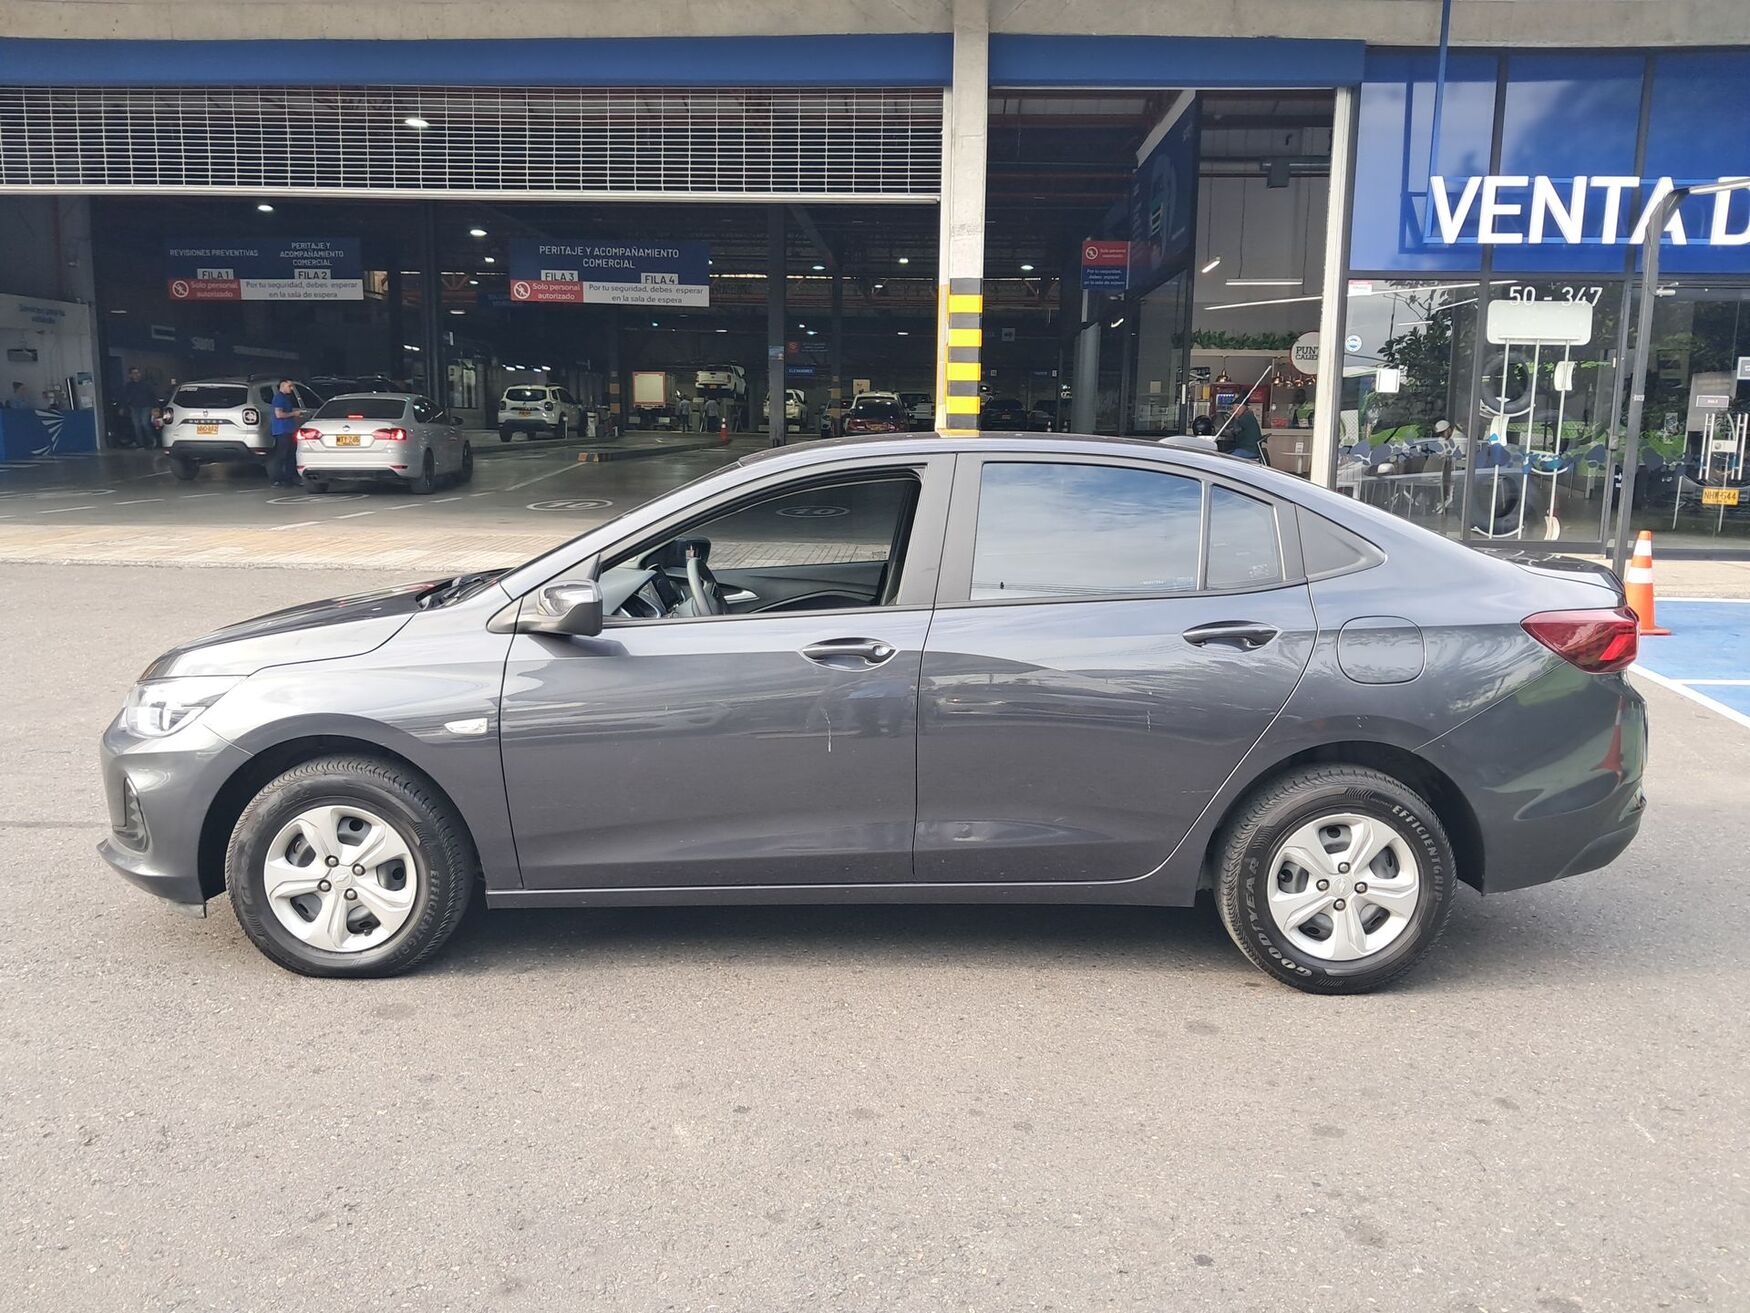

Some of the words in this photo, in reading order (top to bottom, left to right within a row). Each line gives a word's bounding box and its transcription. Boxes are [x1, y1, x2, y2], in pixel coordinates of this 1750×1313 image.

[1430, 175, 1687, 246] VENTA
[539, 245, 584, 256] PERITAJE
[585, 246, 592, 255] Y
[594, 245, 679, 258] ACOMPAÑAMIENTO
[292, 258, 333, 266] COMERCIAL
[583, 258, 636, 269] COMERCIAL
[202, 271, 224, 280] FILA
[298, 271, 320, 280] FILA
[321, 271, 328, 280] 2
[545, 272, 567, 281] FILA
[568, 273, 575, 282] 3
[645, 275, 667, 285] FILA
[668, 276, 676, 285] 4
[532, 282, 548, 291] Solo
[549, 283, 581, 293] personal
[588, 284, 601, 292] Por
[650, 286, 673, 294] debes
[675, 288, 704, 297] esperar
[537, 291, 576, 301] autorizado
[621, 295, 629, 303] la
[630, 295, 646, 303] sala
[646, 296, 657, 304] de
[657, 297, 683, 306] espera
[1509, 286, 1536, 305] 50
[1561, 286, 1604, 307] 347
[1246, 856, 1313, 978] GOODYEAR
